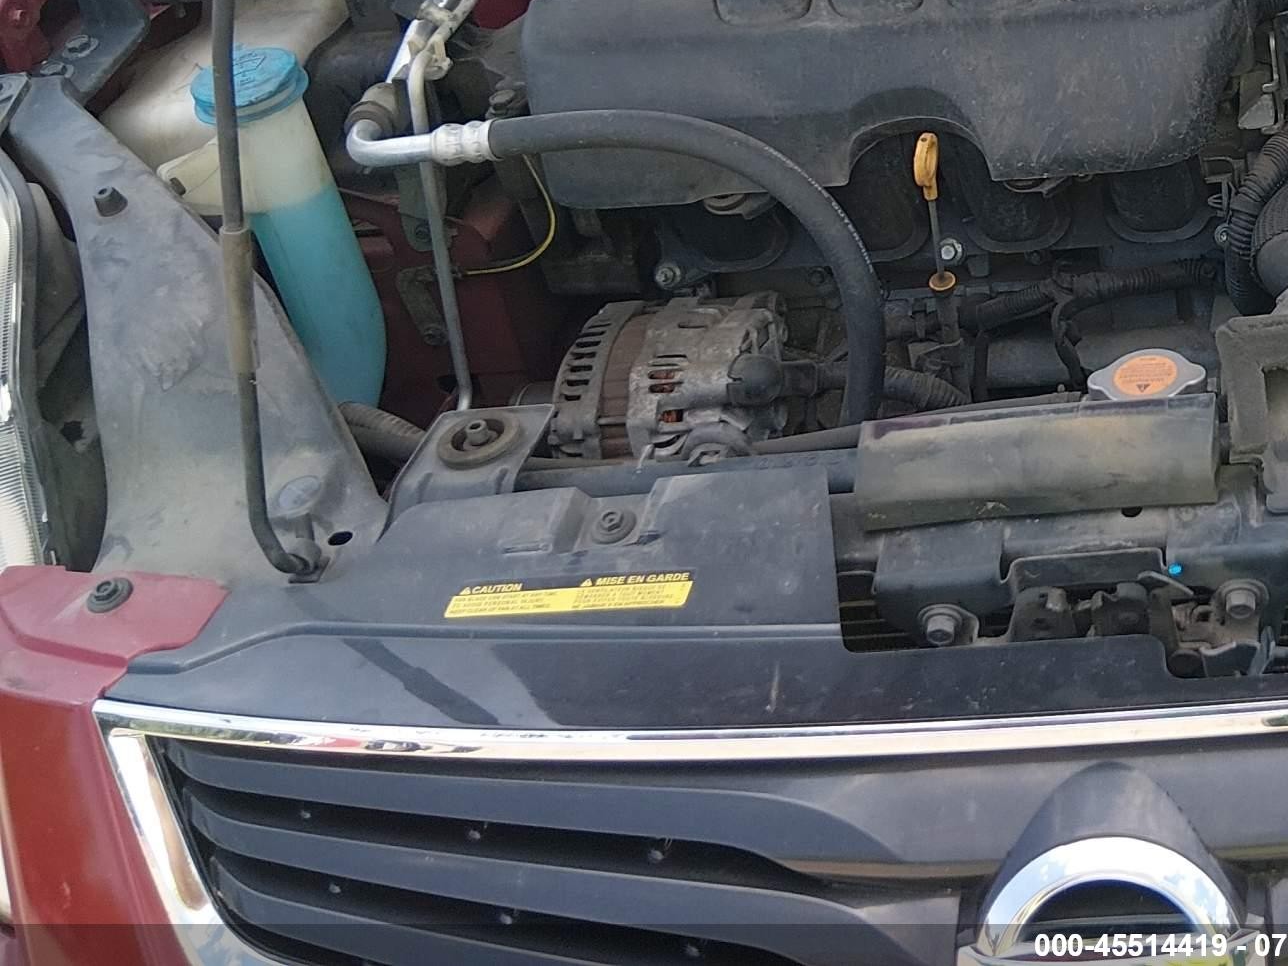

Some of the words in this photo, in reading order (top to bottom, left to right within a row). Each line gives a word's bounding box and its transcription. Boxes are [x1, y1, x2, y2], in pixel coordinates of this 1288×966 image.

[595, 576, 625, 586] MISE
[627, 575, 646, 584] EN
[646, 572, 690, 582] GARDE
[472, 583, 523, 594] CAUTION
